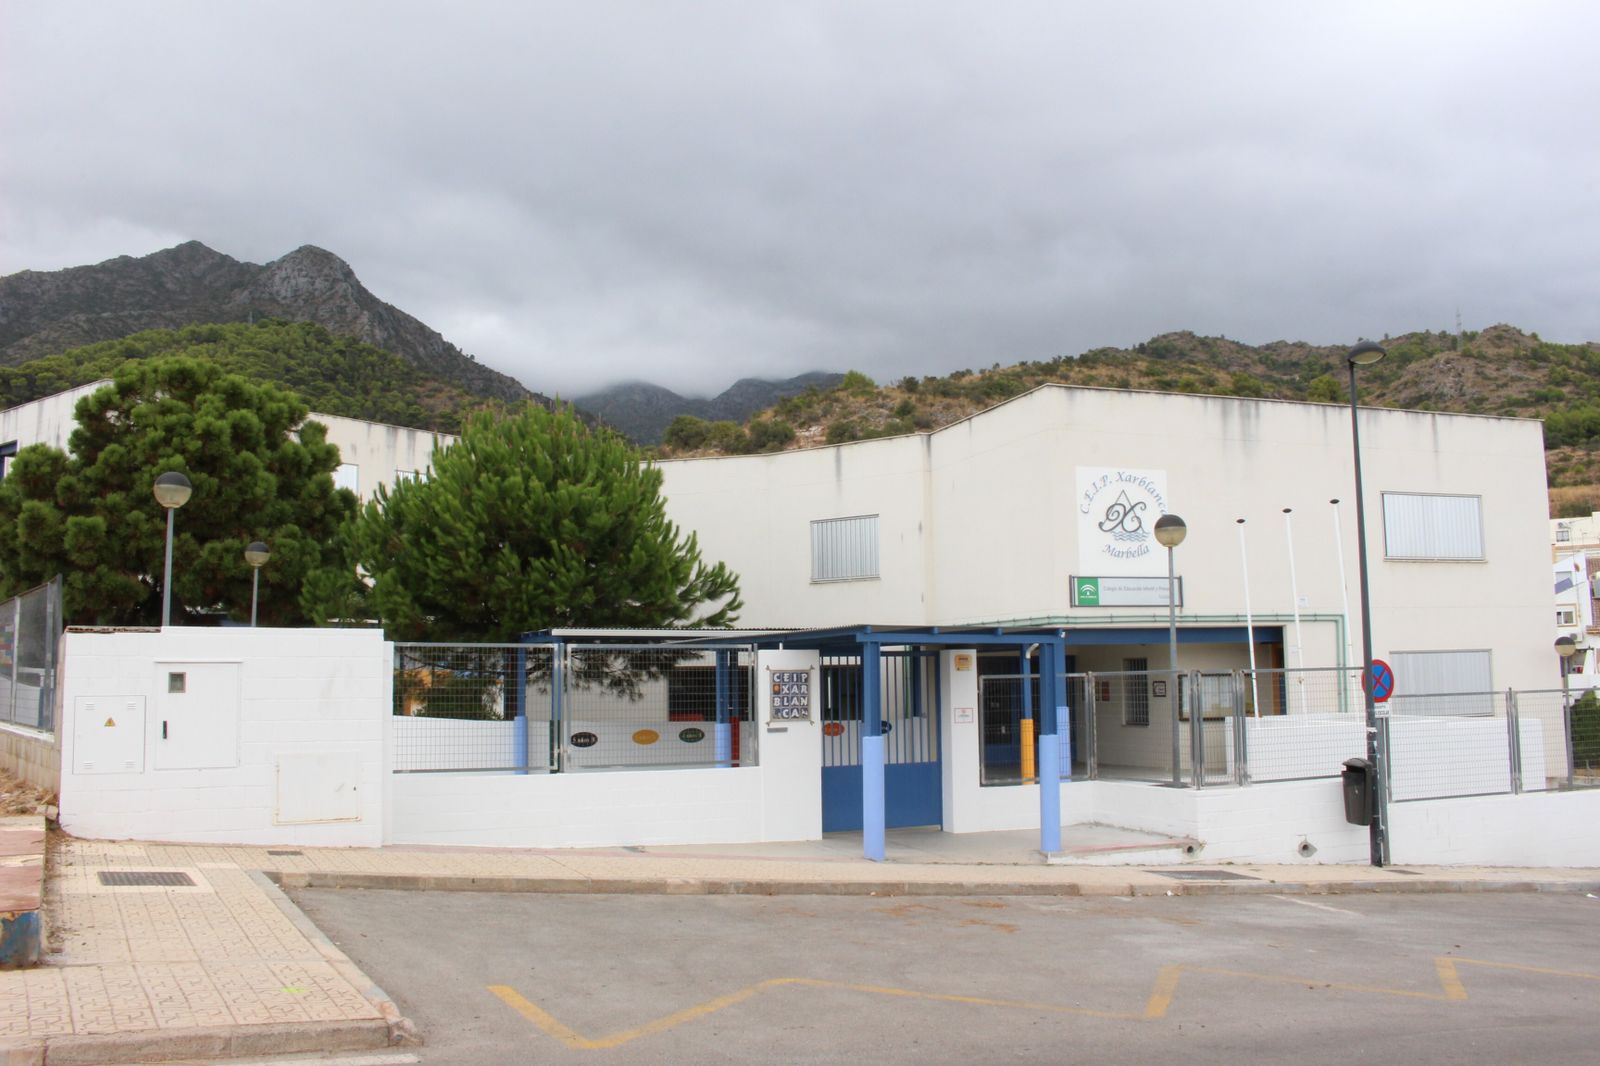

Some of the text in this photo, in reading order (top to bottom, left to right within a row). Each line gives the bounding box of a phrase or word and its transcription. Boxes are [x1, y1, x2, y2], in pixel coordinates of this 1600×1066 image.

[1102, 543, 1150, 559] Marbella
[773, 673, 808, 682] CEIP
[782, 684, 808, 694] XAR
[773, 696, 808, 707] BLAN
